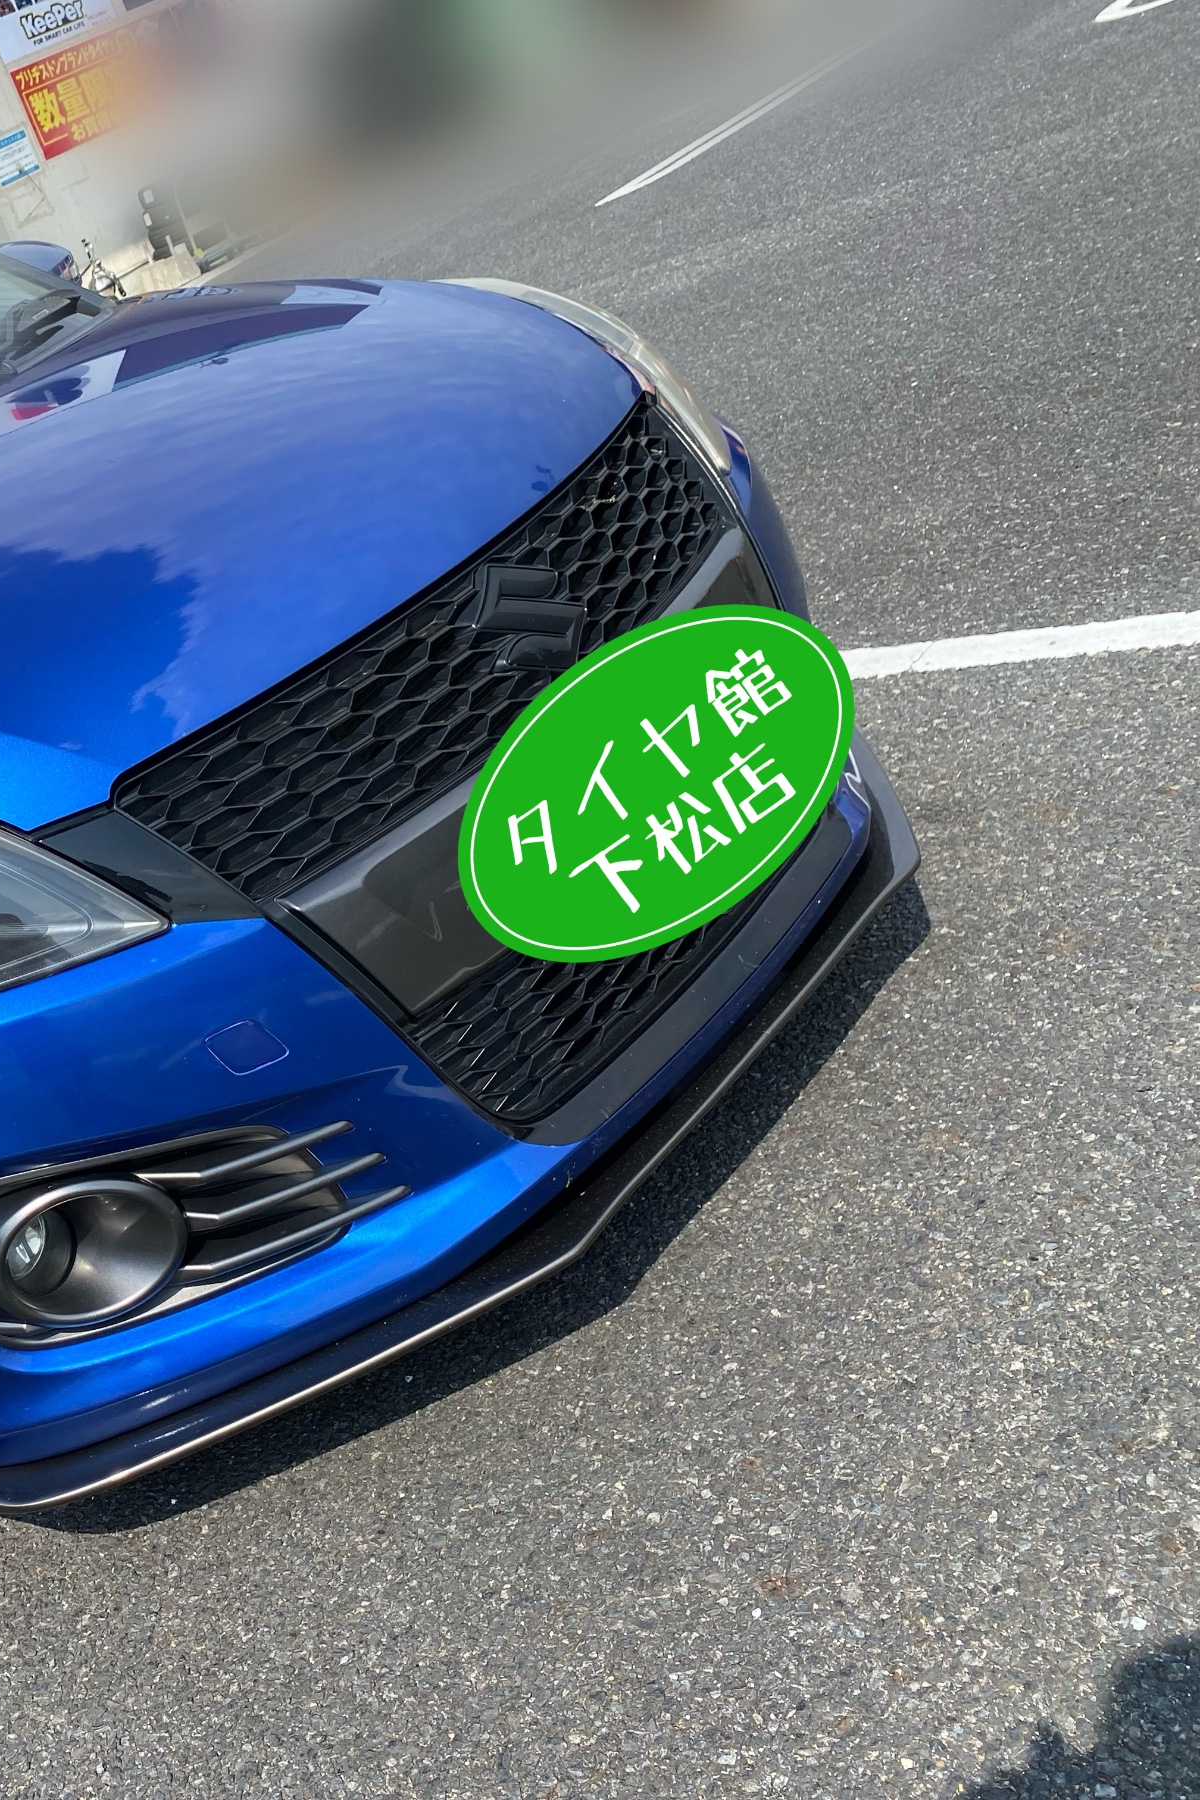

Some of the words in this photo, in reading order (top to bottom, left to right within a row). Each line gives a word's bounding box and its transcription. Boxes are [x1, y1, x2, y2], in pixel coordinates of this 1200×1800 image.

[20, 0, 83, 39] KeePer
[33, 36, 44, 46] FOR
[45, 30, 61, 42] SMART
[63, 26, 72, 35] CAR
